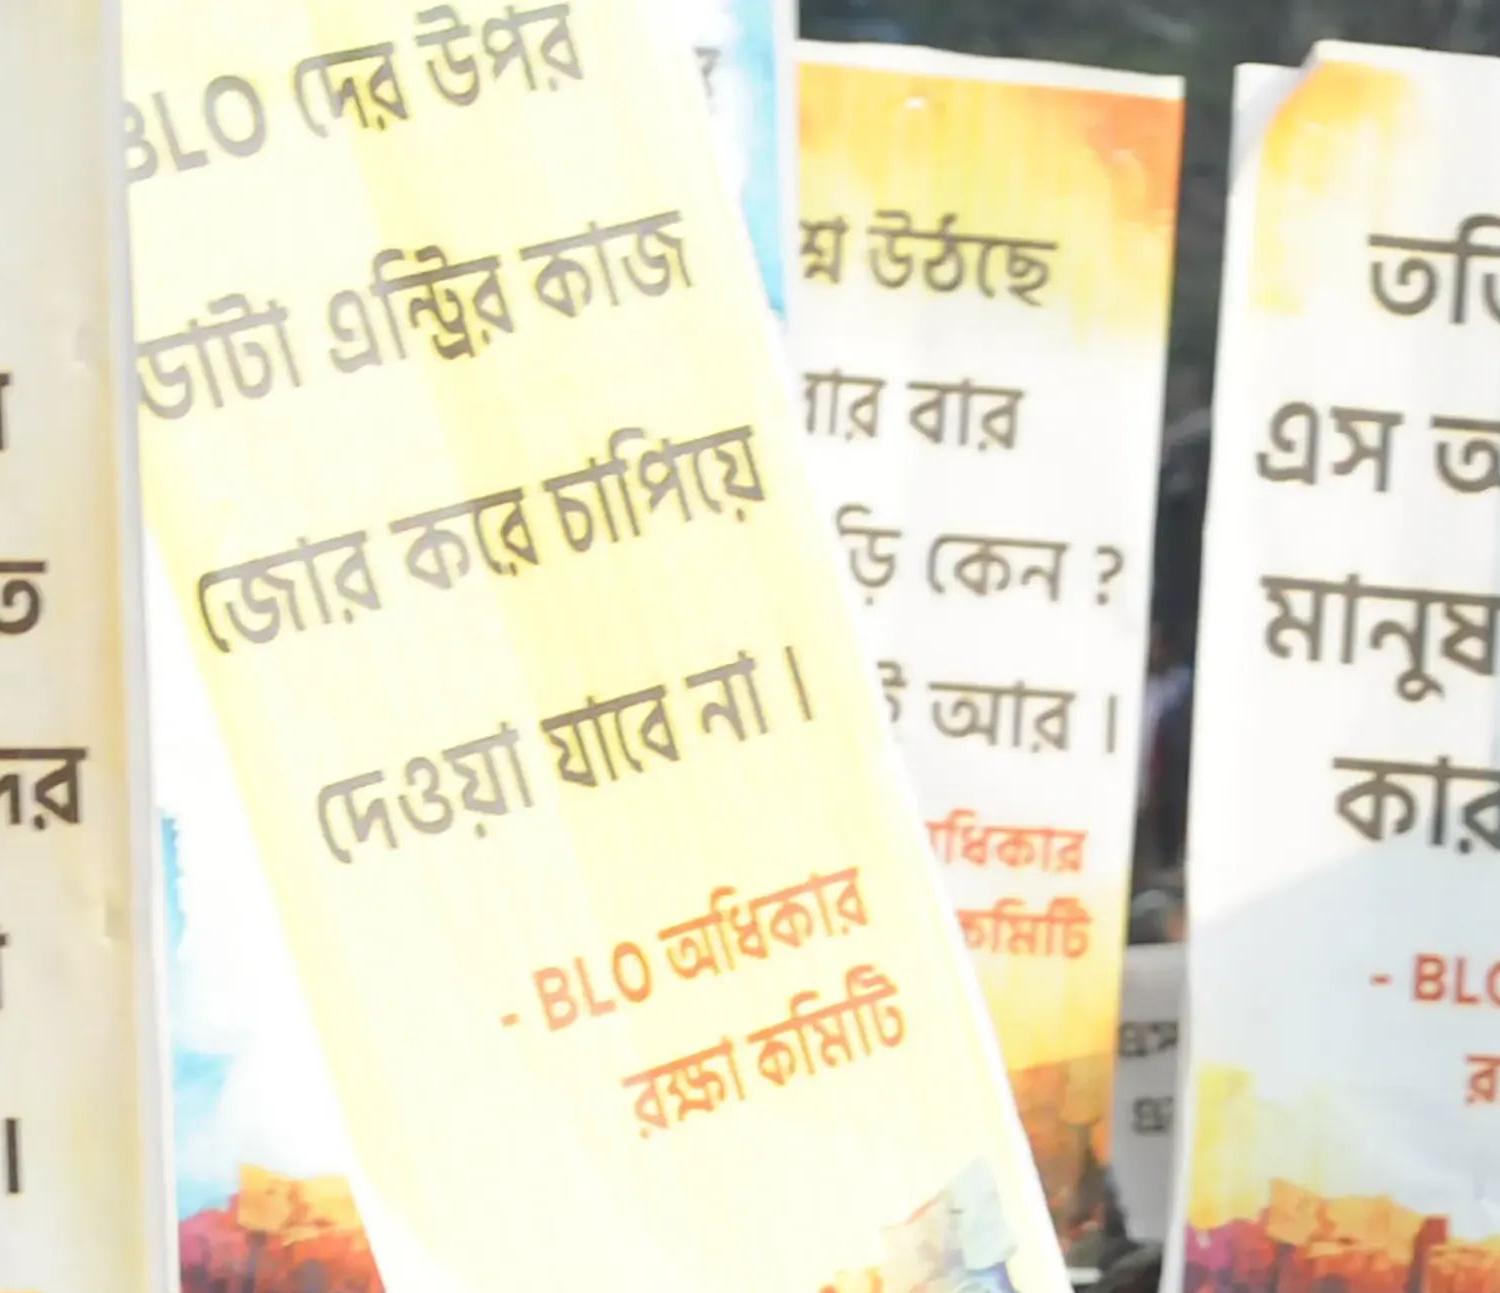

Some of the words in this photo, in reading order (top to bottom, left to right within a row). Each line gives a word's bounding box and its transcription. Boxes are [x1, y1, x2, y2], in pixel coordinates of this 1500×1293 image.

[294, 42, 408, 135] দের
[415, 3, 583, 107] উপর
[519, 211, 691, 318] কাজ
[907, 379, 1024, 450] বার
[1256, 402, 1403, 492] এস
[197, 530, 381, 653] জোর
[390, 487, 539, 588] করে
[542, 425, 765, 553] চাপিয়ে
[927, 535, 1068, 601] কেন
[317, 722, 533, 864] দেওয়া
[540, 685, 679, 787] যাবে
[685, 651, 768, 741] না
[928, 682, 1076, 752] আর
[534, 942, 651, 1030] BLO
[658, 868, 867, 979] অধিকার
[623, 1039, 743, 1137] রক্ষা
[747, 965, 903, 1085] কমিটি
